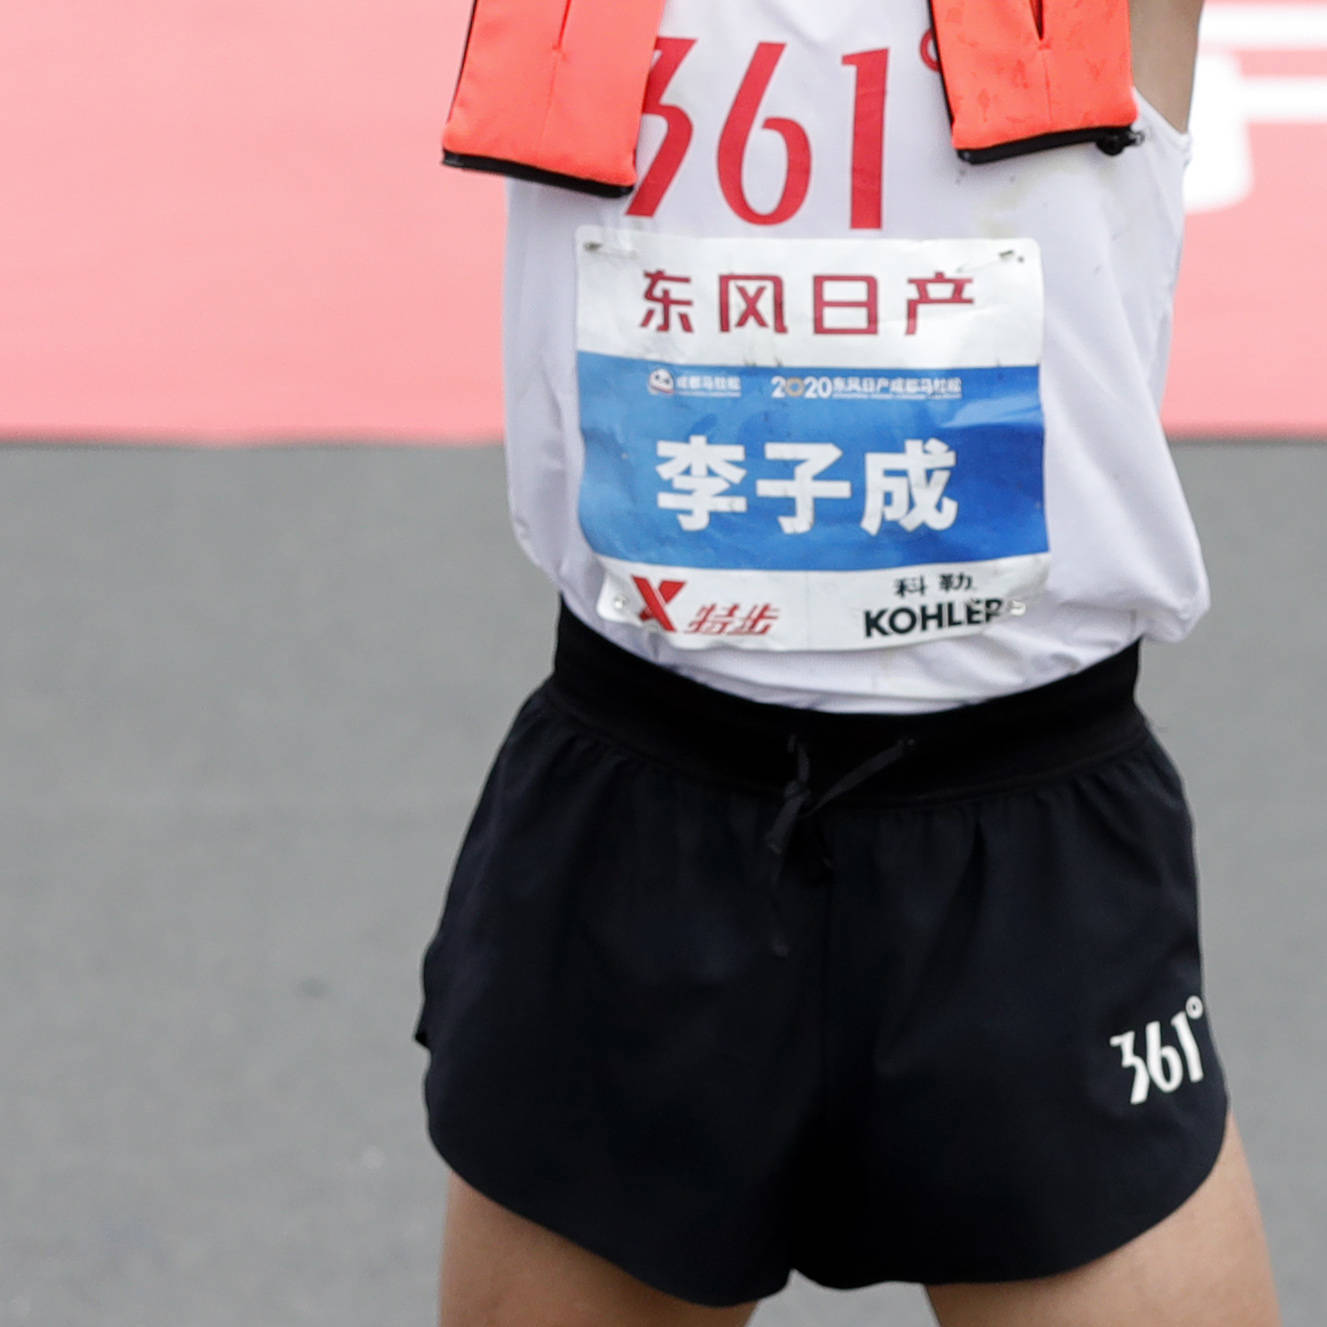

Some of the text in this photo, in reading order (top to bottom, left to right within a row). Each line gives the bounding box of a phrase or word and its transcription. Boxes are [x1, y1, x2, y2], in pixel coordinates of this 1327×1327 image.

[638, 270, 975, 336] 东风日产
[655, 434, 959, 536] 李子成
[683, 603, 780, 635] 特步
[863, 597, 1003, 639] KOHLER
